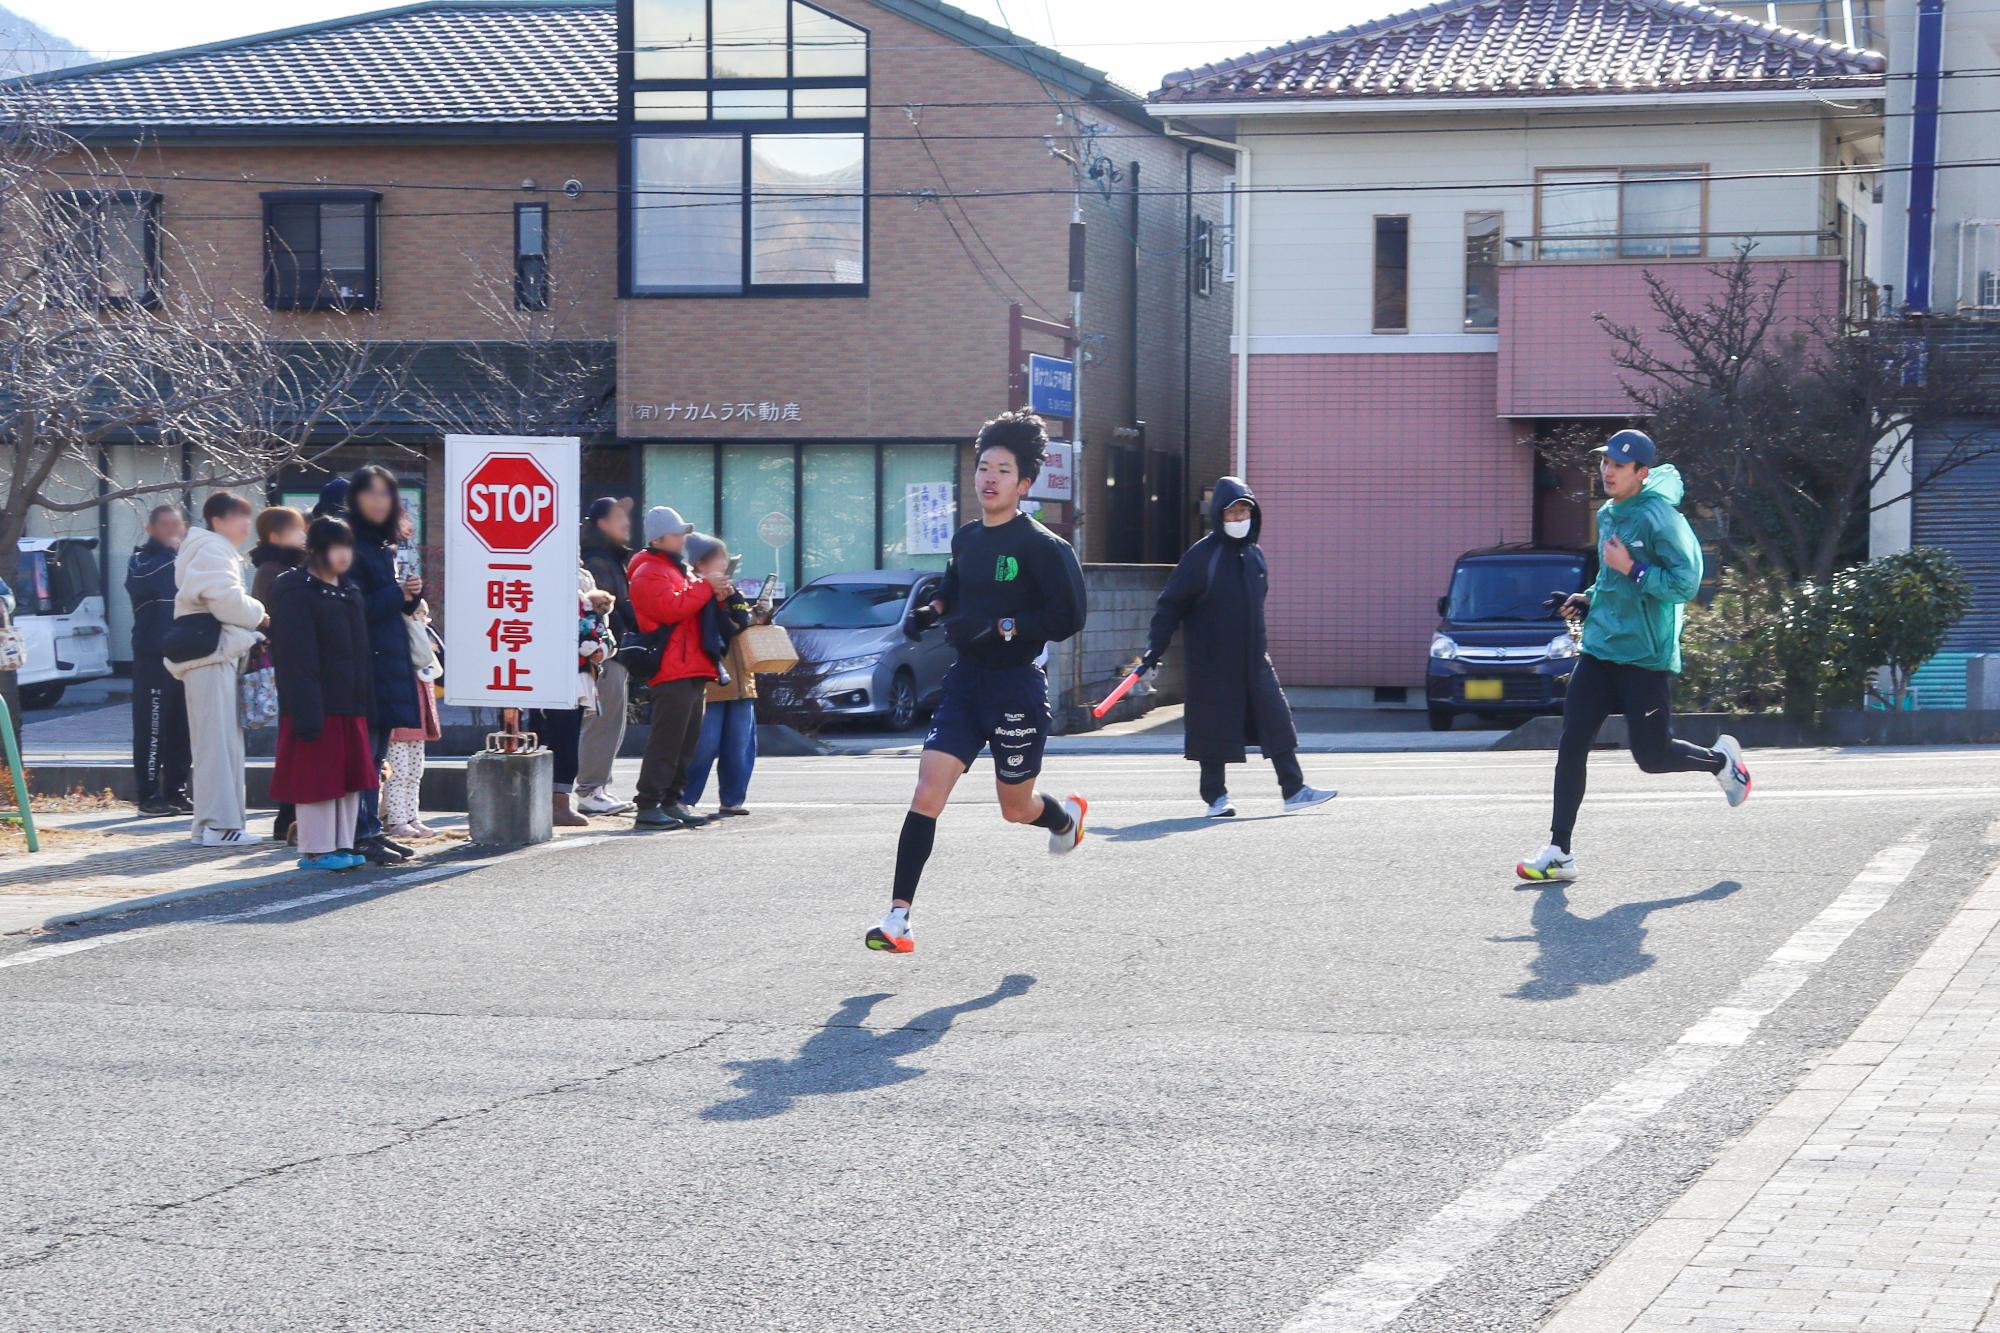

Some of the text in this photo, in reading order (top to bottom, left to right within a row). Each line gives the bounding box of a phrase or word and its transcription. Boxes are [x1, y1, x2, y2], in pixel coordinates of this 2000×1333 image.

[630, 402, 802, 422] (有)ナカムラ不動産
[469, 483, 551, 522] STOP
[486, 562, 534, 692] 一時停止
[147, 697, 161, 781] UNDER ARMOUR
